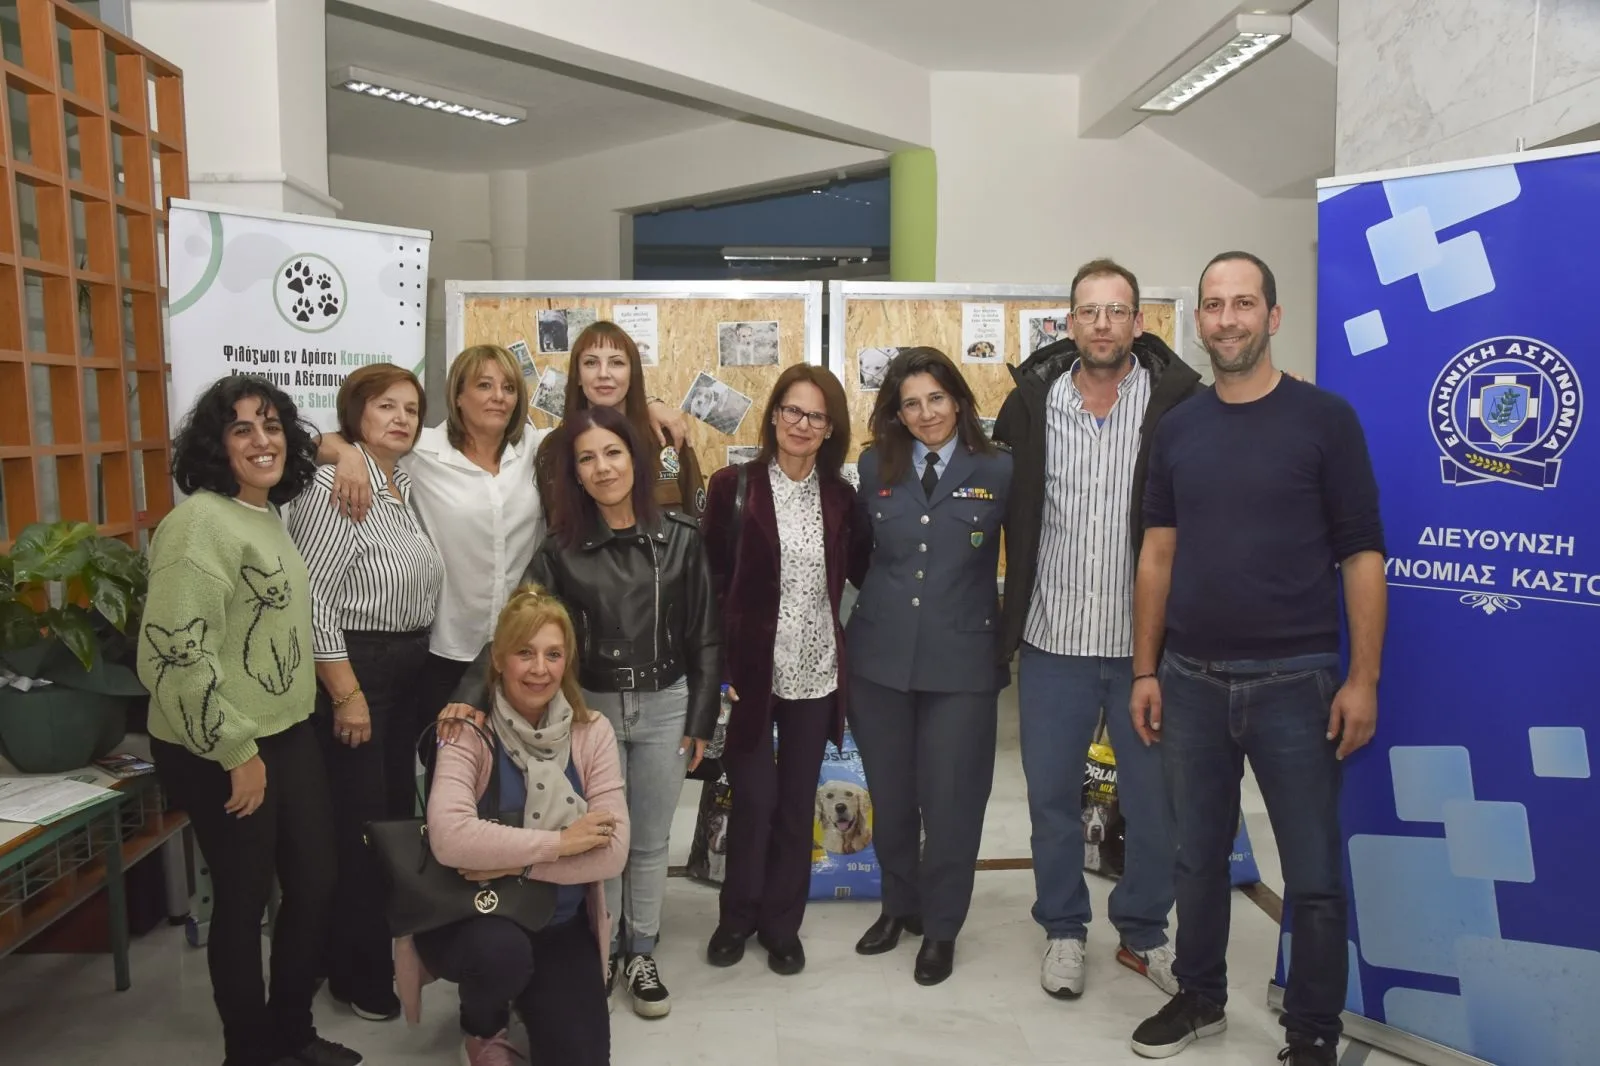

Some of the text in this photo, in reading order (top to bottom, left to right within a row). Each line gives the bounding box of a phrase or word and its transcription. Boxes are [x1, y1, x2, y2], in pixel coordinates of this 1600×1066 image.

[223, 345, 280, 365] Φιλόζωοι
[284, 350, 297, 364] εν
[301, 348, 337, 367] Δράσει
[295, 370, 347, 386] Αδέσποτω
[308, 392, 336, 408] Shelt
[1437, 343, 1576, 450] ΕΛΛΗΝΙΚΗ ΑΣΤΥΝΟΜΙΑ
[1417, 526, 1575, 557] ΔΙΕΥΘΥΝΣΗ
[1384, 557, 1600, 596] ΥΝΟΜΙΑΣ ΚΑΣΤΟ
[847, 862, 858, 871] 10
[858, 862, 871, 873] kg
